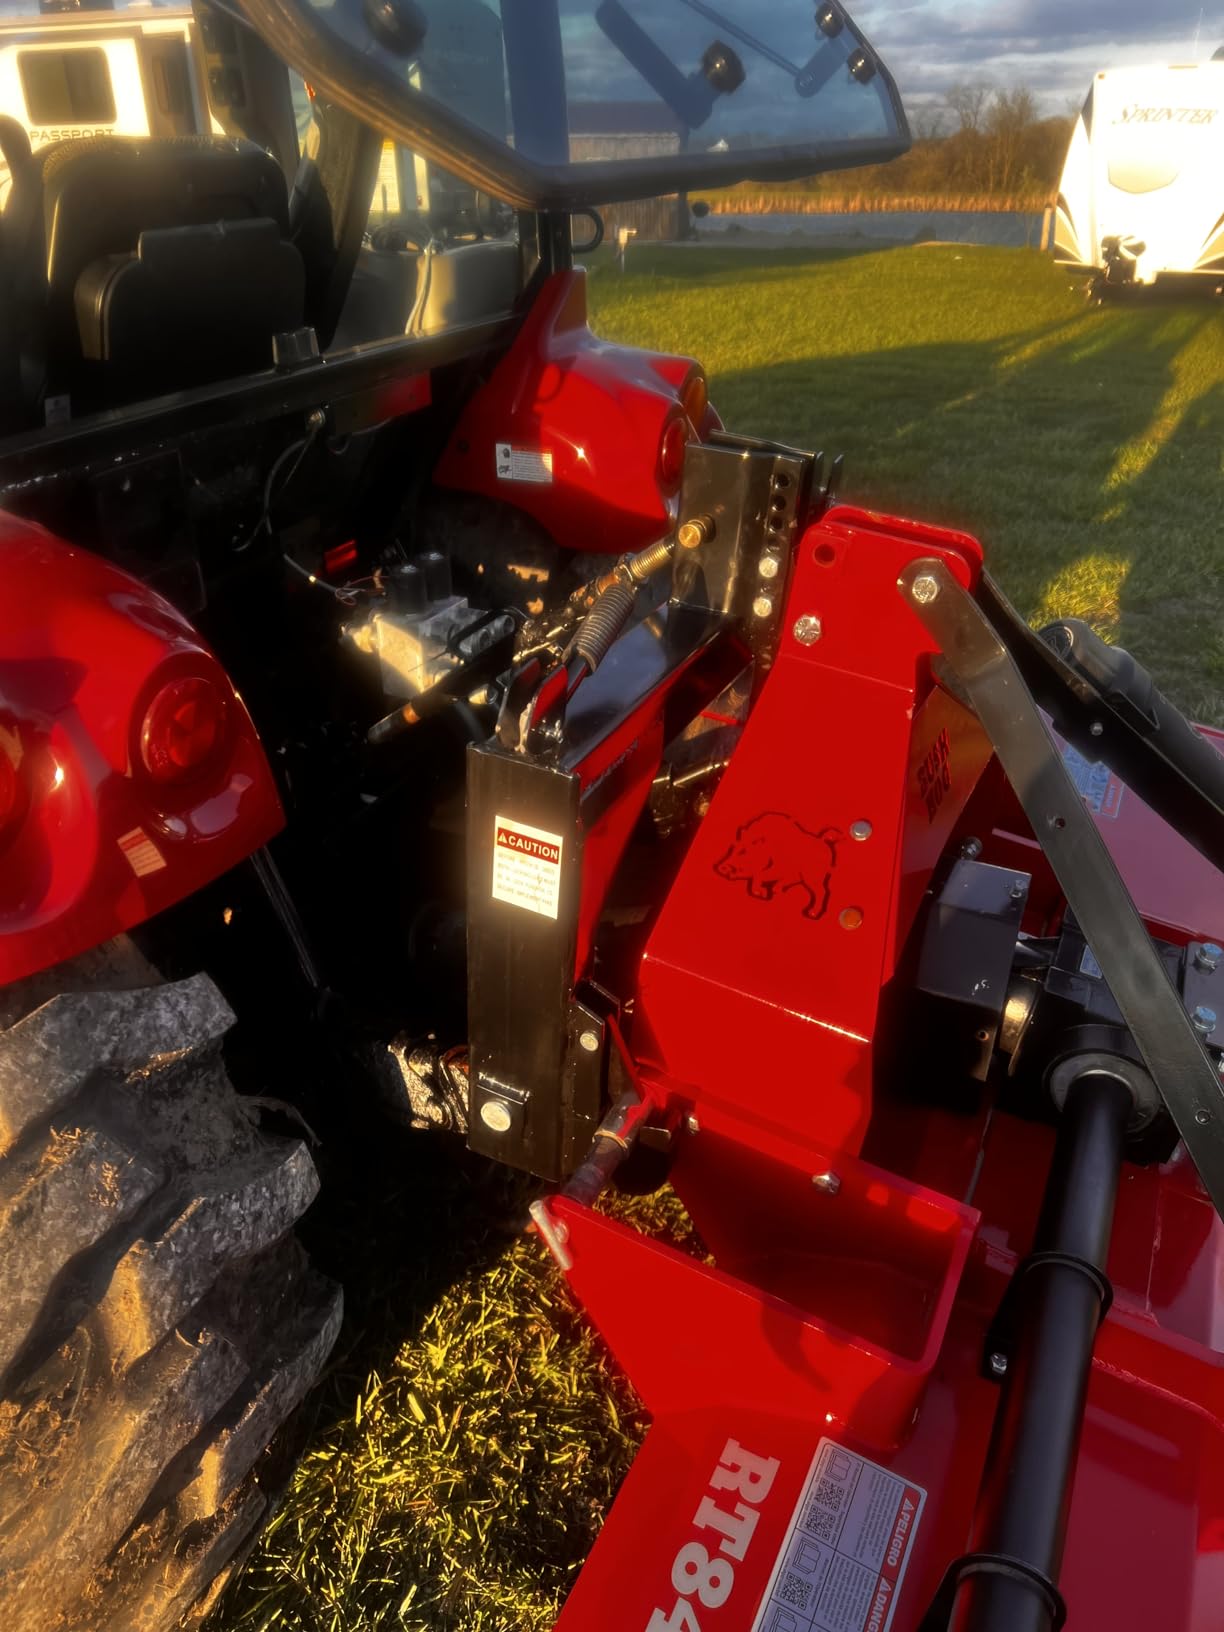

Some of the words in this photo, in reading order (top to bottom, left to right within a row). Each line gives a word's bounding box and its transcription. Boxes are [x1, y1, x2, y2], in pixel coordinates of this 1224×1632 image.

[29, 129, 114, 141] PASSPORT
[508, 835, 559, 860] CAUTION
[887, 1512, 911, 1567] PELIGRO
[866, 1592, 888, 1632] DANG
